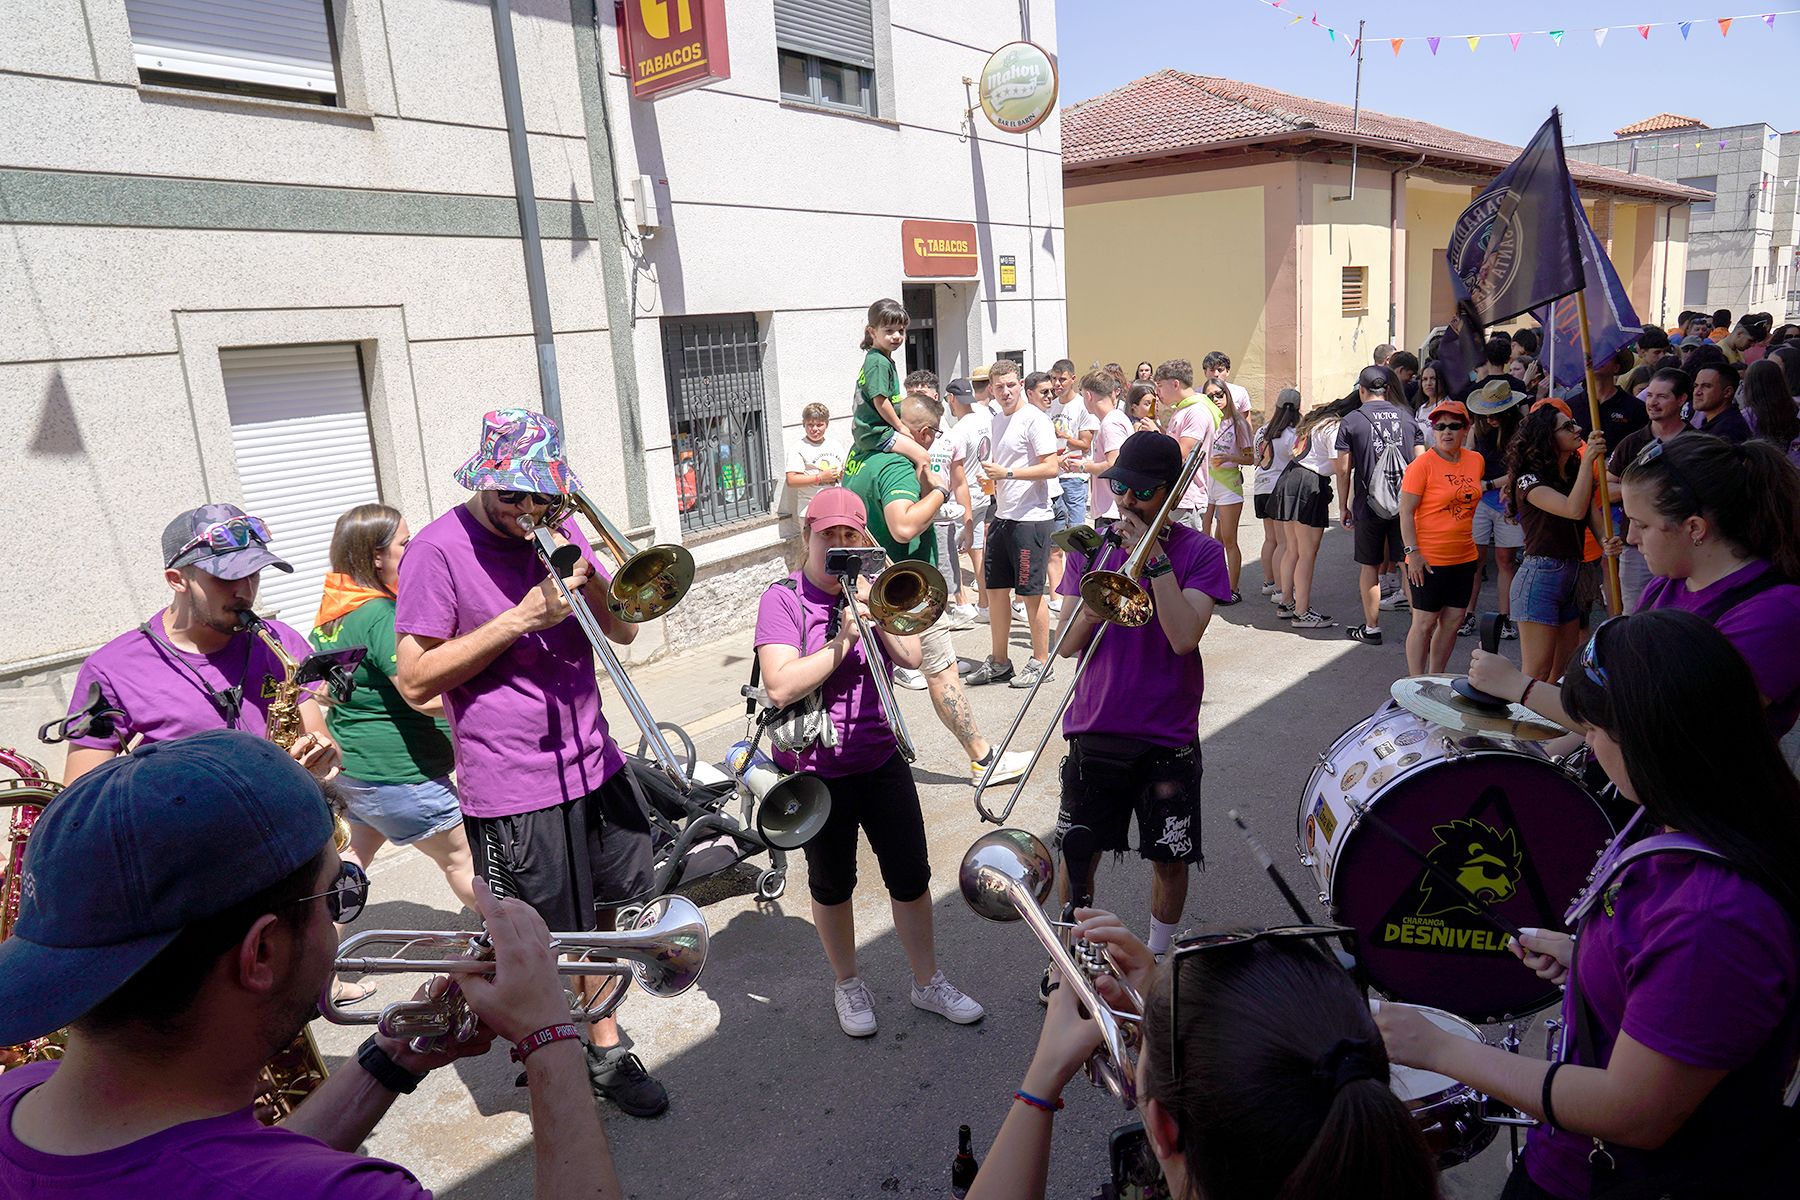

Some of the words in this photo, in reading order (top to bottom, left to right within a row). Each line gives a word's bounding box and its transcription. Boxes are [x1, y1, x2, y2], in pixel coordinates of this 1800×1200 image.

[638, 42, 703, 77] TABACOS
[997, 117, 1009, 127] BAR
[927, 239, 969, 253] TABACOS
[1402, 916, 1445, 928] CHARANGA
[1383, 922, 1512, 951] DESNIVELA
[533, 1029, 553, 1045] LOS
